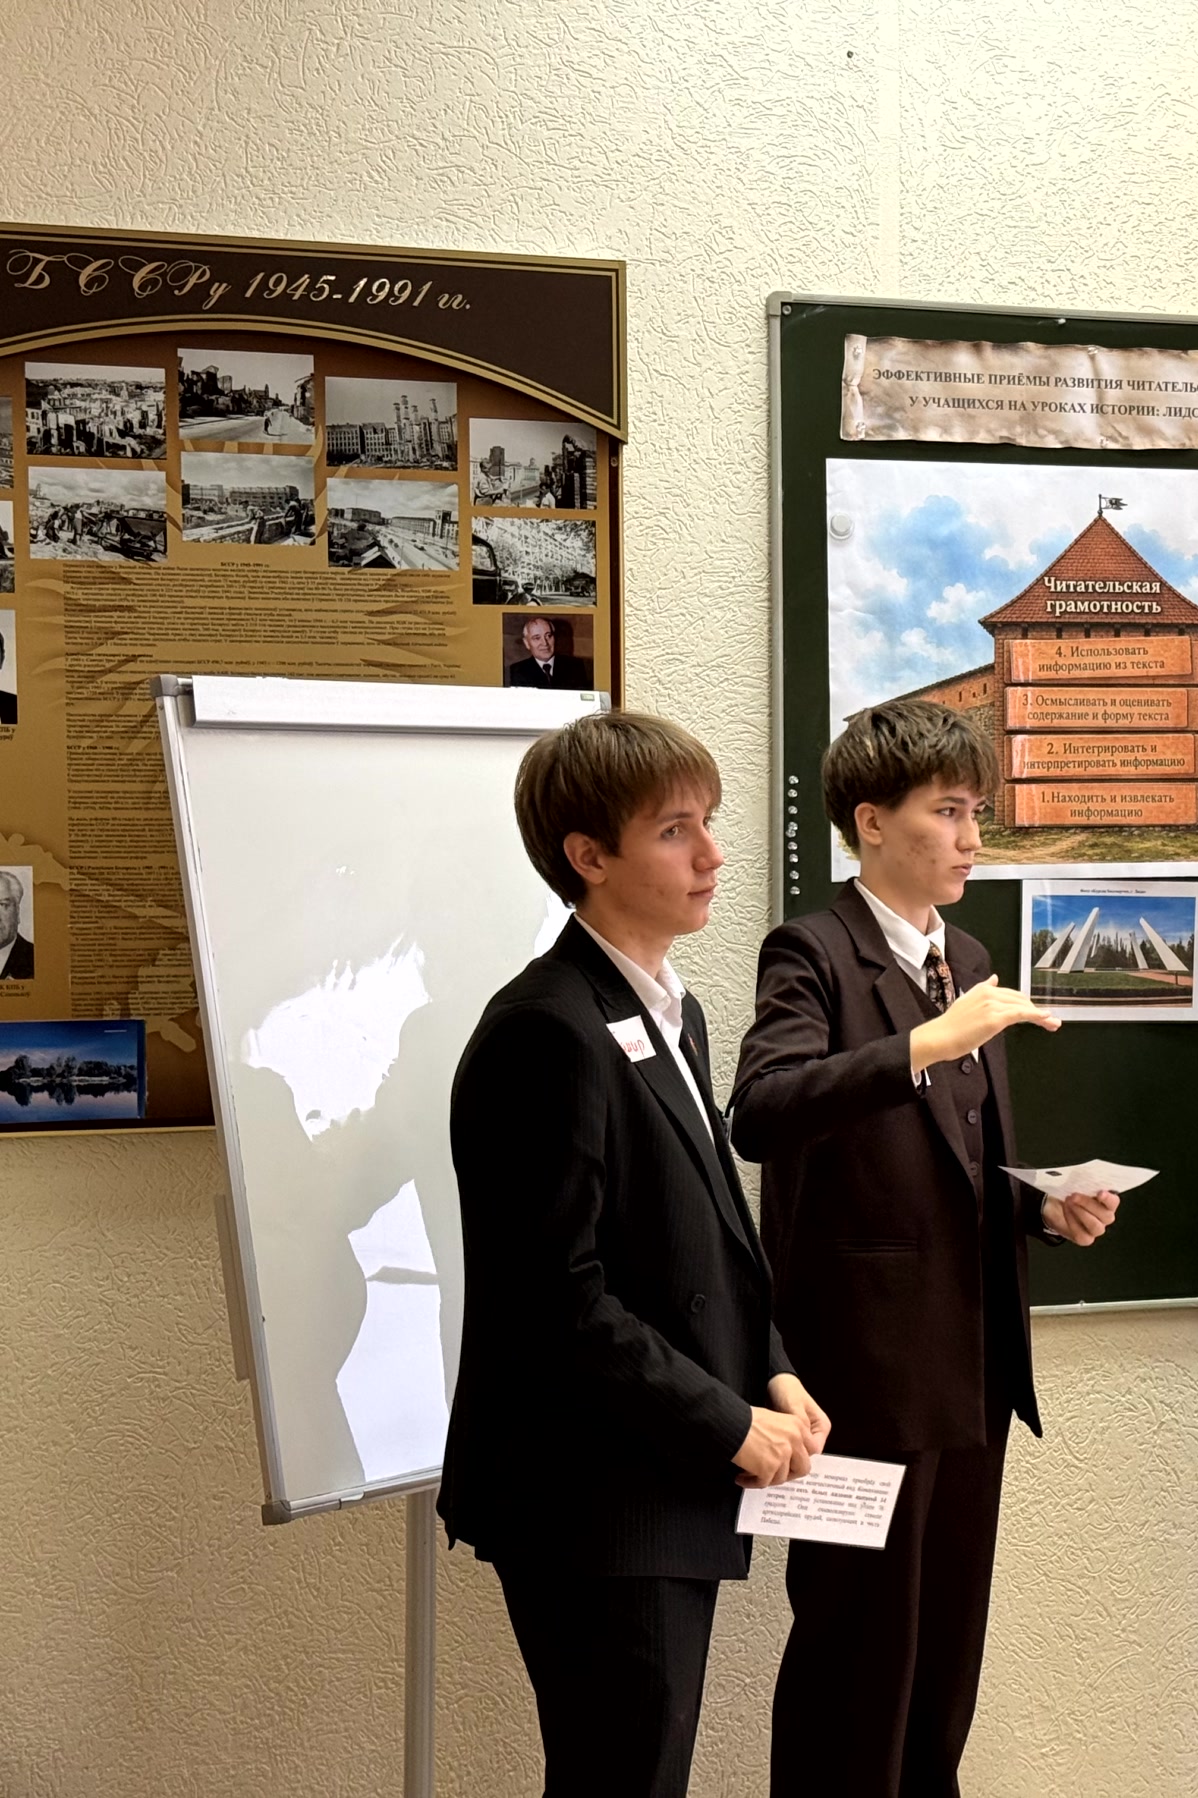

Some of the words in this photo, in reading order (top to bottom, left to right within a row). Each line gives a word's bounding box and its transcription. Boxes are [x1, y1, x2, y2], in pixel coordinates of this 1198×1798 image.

[245, 272, 432, 306] 1945-1991
[873, 368, 984, 385] ЭФФЕКТИВНЫЕ
[988, 373, 1050, 387] ПРИЁМЫ
[1054, 377, 1122, 390] РАЗВИТИЯ
[909, 396, 919, 407] У
[922, 397, 1004, 411] УЧАЩИХСЯ
[1008, 400, 1028, 411] НА
[1031, 401, 1087, 414] УРОКАХ
[1090, 404, 1160, 417] ИСТОРИИ:
[1044, 576, 1161, 594] Читательская
[1046, 600, 1162, 616] грамотность
[1055, 646, 1067, 658] 4.
[1071, 646, 1148, 659] Использовать
[1038, 660, 1112, 675] информацию
[1115, 661, 1127, 670] из
[1131, 660, 1165, 670] текста
[1022, 695, 1033, 707] 3.
[1035, 695, 1108, 708] Осмысливать
[1110, 698, 1117, 707] и
[1119, 697, 1172, 709] оценивать
[1027, 710, 1090, 723] содержание
[1092, 711, 1099, 720] и
[1101, 709, 1135, 723] форму
[1138, 710, 1170, 721] текста
[1047, 742, 1058, 755] 2.
[1063, 742, 1147, 756] Интегрировать
[1150, 744, 1157, 753] и
[1024, 759, 1117, 771] интерпретировать
[1120, 757, 1185, 770] информацию
[1110, 794, 1117, 803] и
[1120, 794, 1174, 803] извлекать
[1070, 806, 1143, 819] информацию
